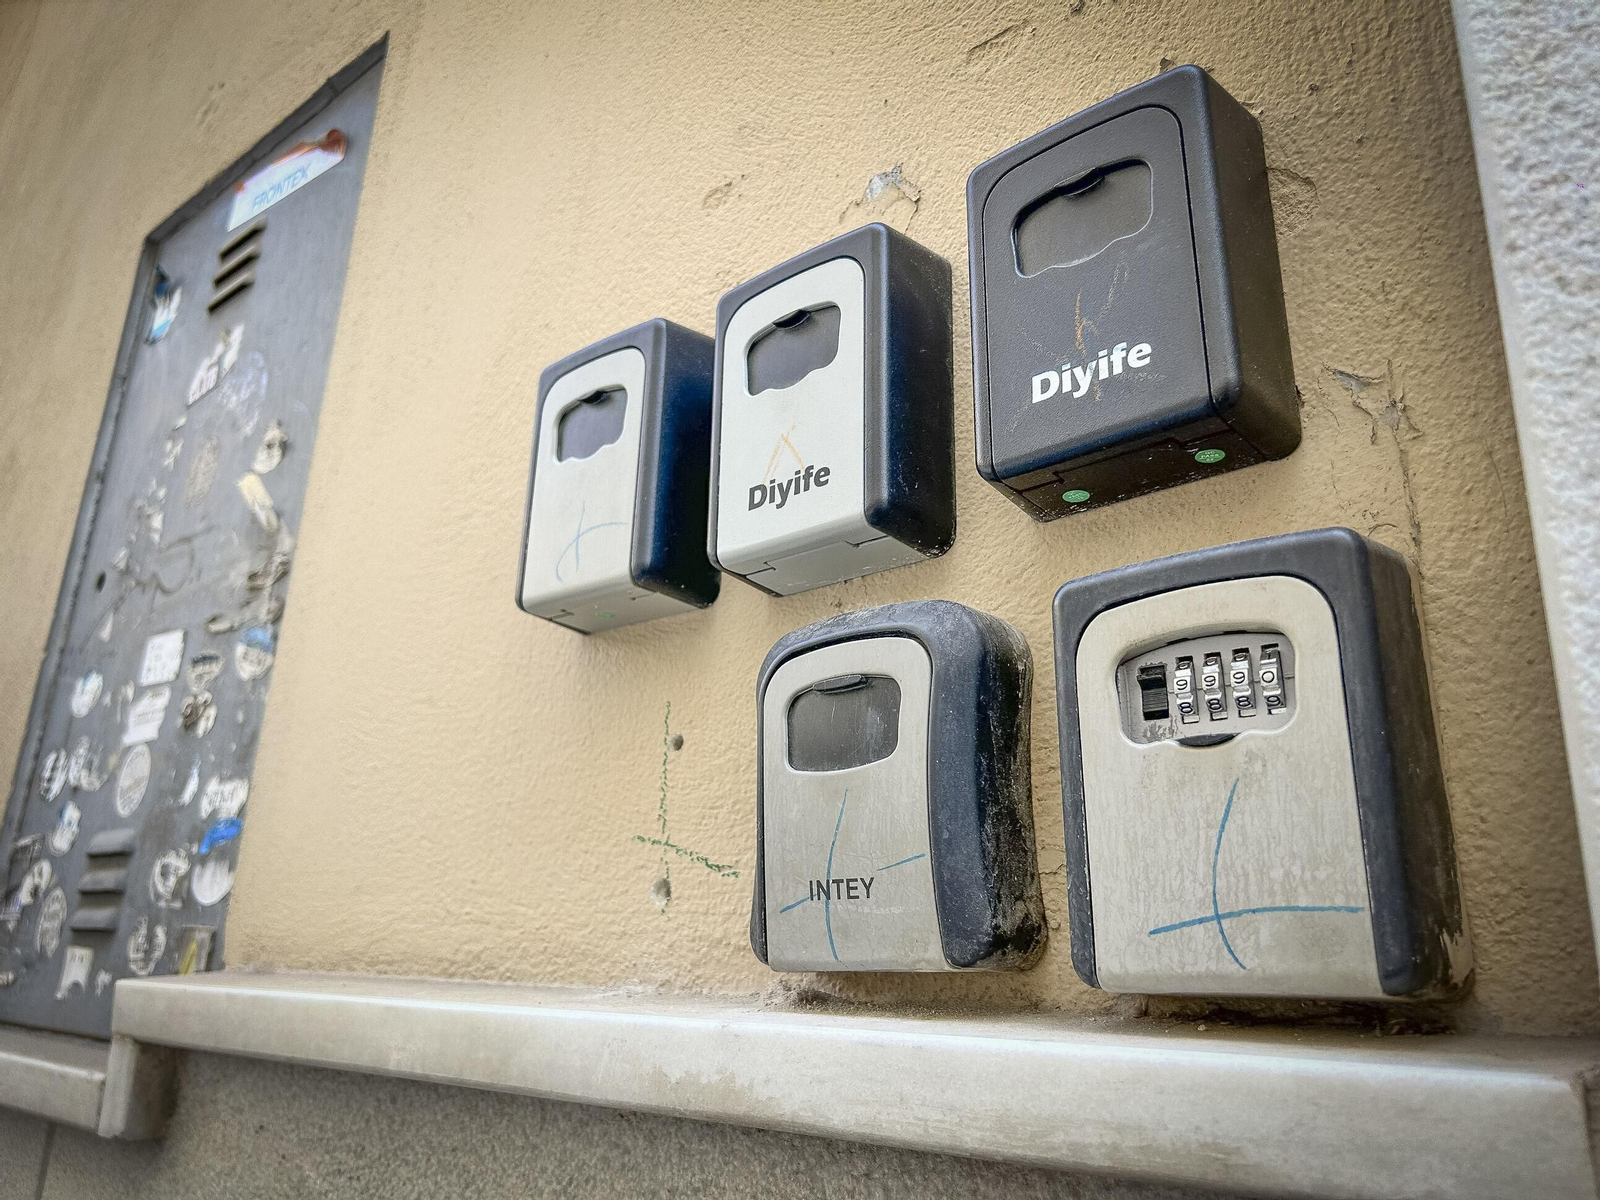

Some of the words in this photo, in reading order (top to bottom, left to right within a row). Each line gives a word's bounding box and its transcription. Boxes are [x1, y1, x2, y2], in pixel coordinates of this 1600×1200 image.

[252, 162, 312, 212] FRONTEX
[1031, 342, 1152, 404] Diyife
[748, 464, 831, 511] Diyife
[809, 877, 875, 901] INTEY
